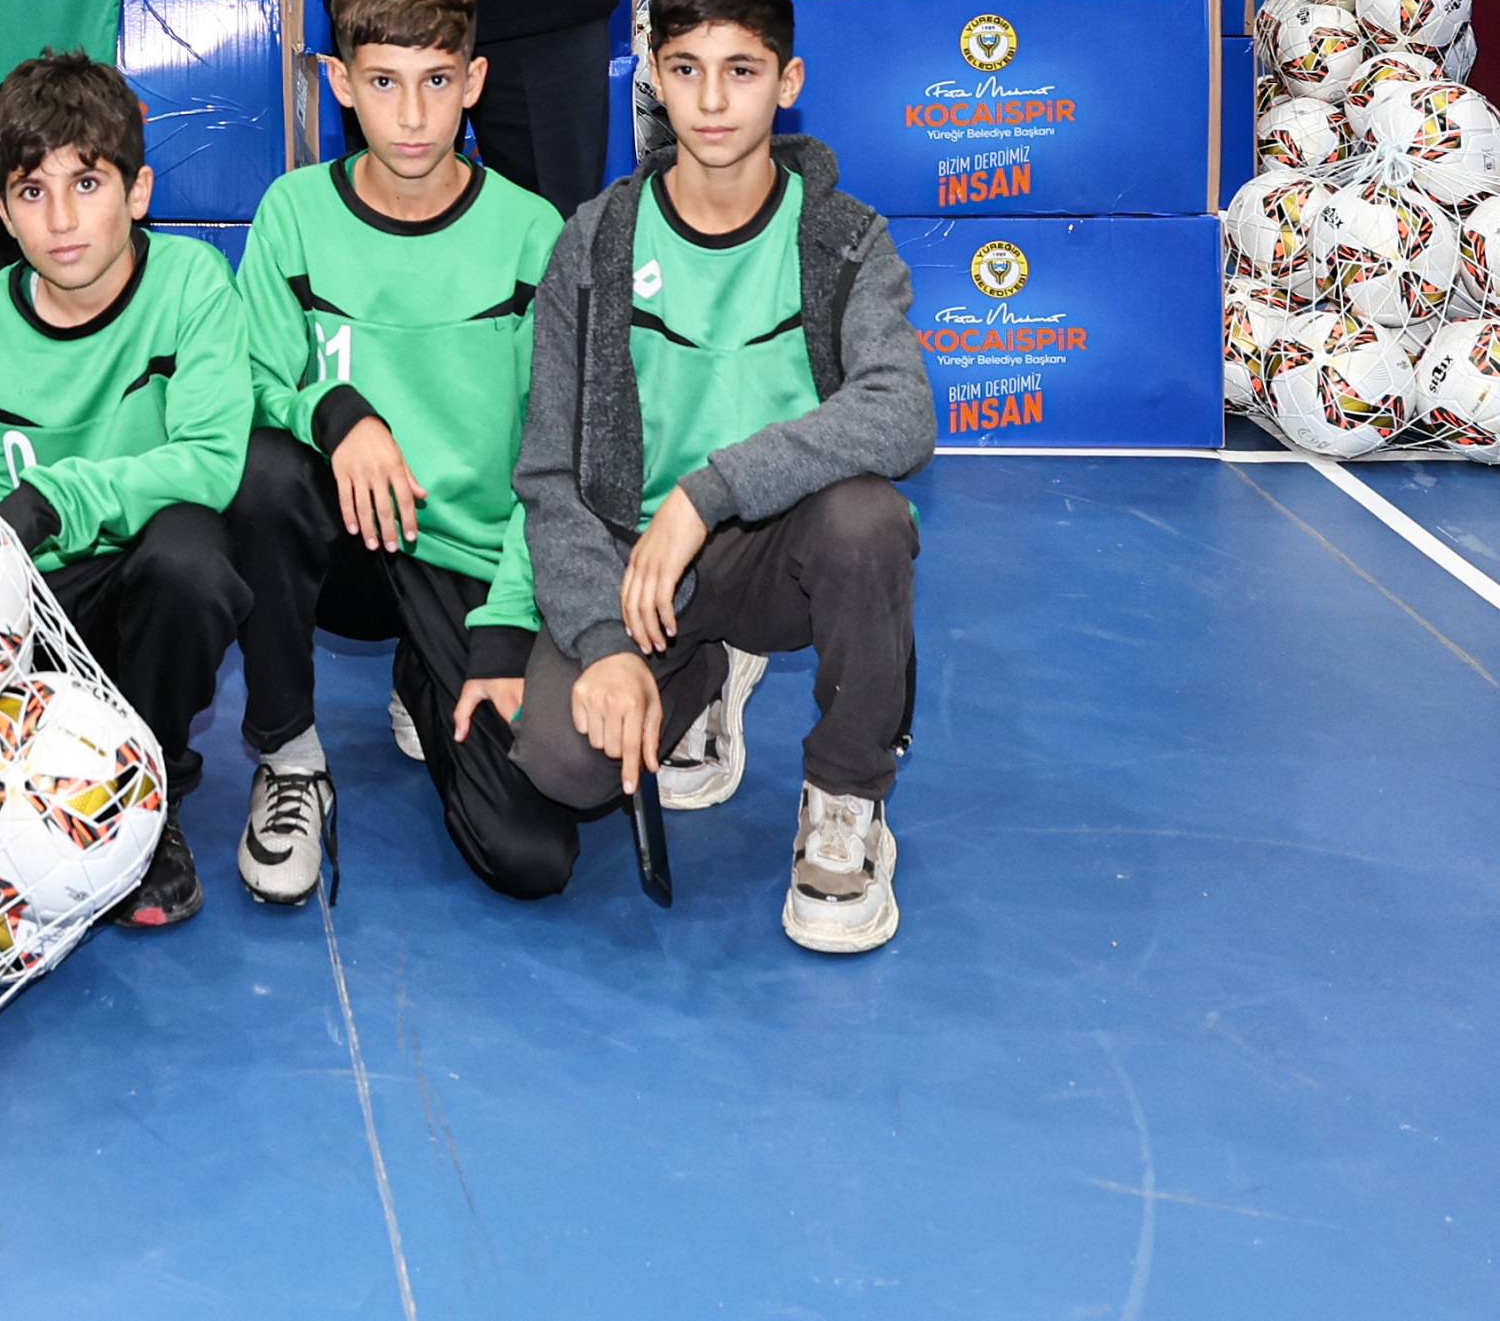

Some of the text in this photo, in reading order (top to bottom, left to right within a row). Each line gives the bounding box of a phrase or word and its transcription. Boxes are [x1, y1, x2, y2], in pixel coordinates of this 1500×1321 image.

[927, 127, 1055, 142] Yüreğir Belediye Başkanı
[938, 144, 1030, 177] BİZİM DERDİMİZ
[937, 355, 1066, 368] Yüreğir Belediye Başkanı
[949, 372, 1042, 403] BİZİM DERDİMİZ
